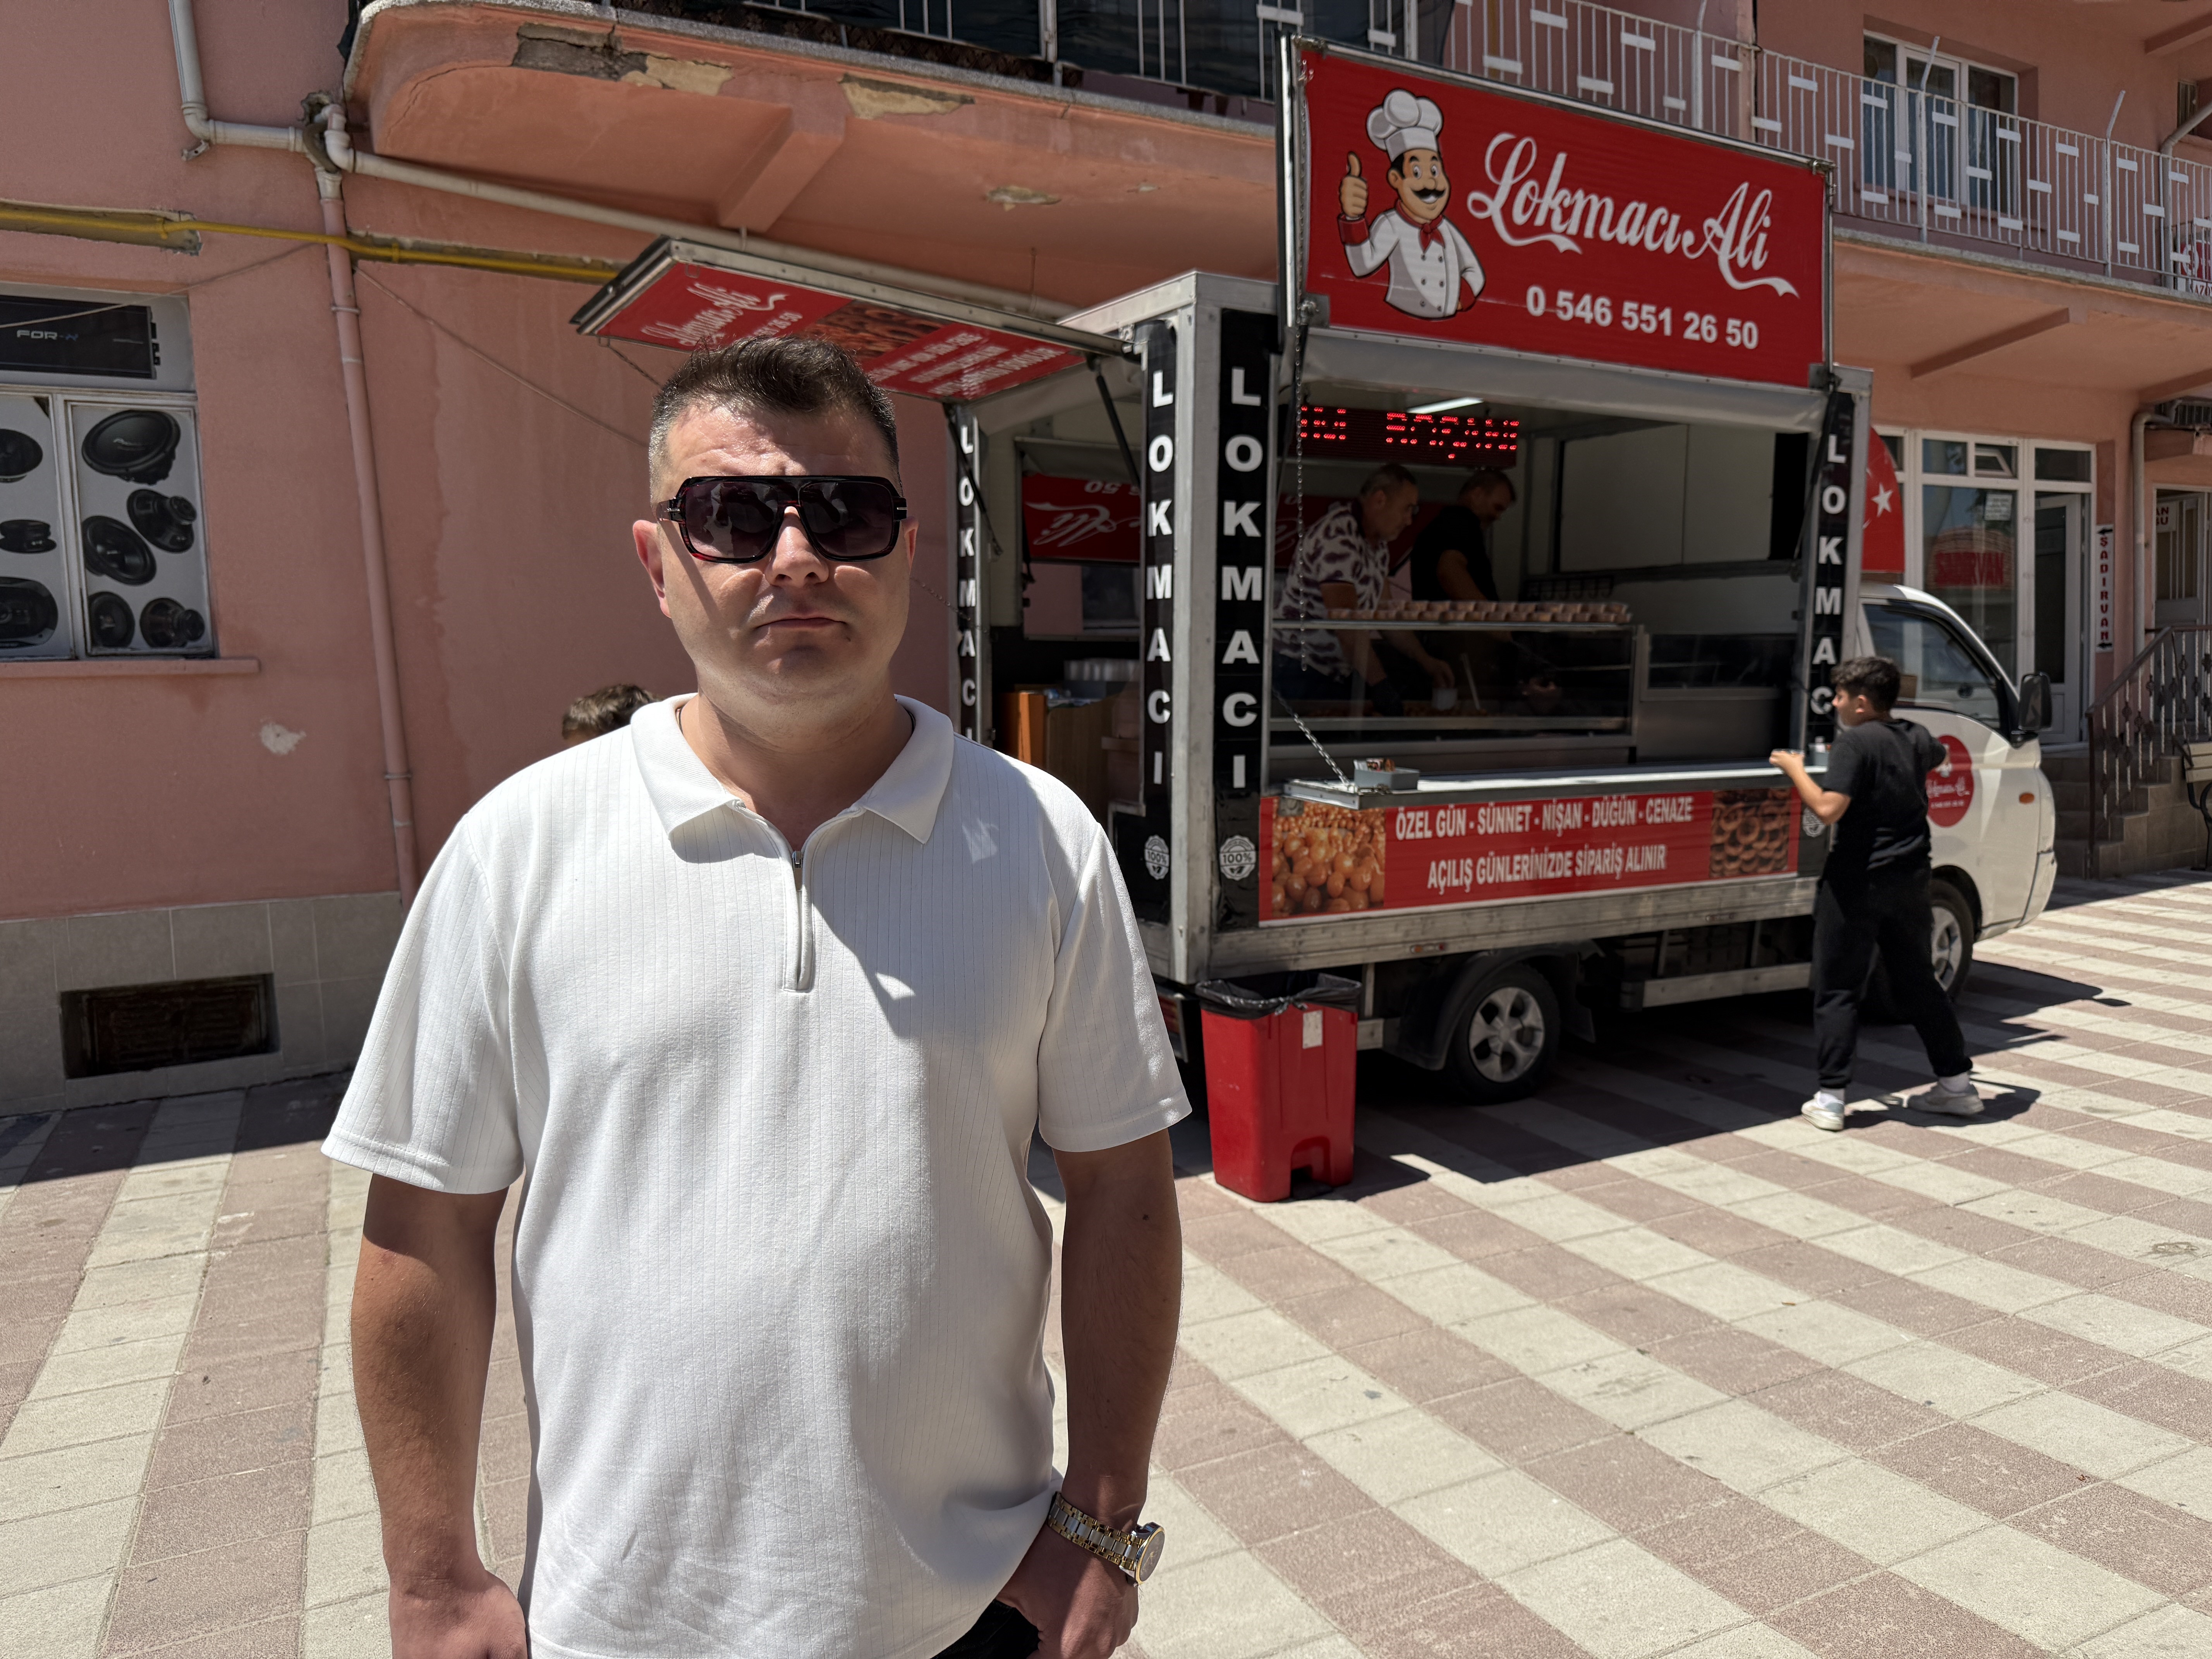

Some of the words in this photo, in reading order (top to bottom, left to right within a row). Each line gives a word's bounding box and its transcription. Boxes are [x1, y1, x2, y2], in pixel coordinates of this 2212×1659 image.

[1682, 181, 1800, 299] Ali
[1526, 285, 1546, 316] 0
[1556, 290, 1612, 327] 546
[1621, 299, 1673, 337] 551
[1683, 311, 1719, 344] 26
[1726, 318, 1759, 349] 50
[1146, 370, 1174, 785] LOKMACI
[1221, 367, 1263, 788] LOKMACI
[1810, 434, 1847, 743] LOKMAC
[1396, 806, 1432, 841] ÖZEL
[1436, 803, 1467, 838] GÜN
[1477, 801, 1533, 835] SÜNNET
[1542, 798, 1583, 837] NİŞAN
[1592, 794, 1638, 828] DÜĞÜN
[1645, 796, 1694, 824] CENAZE
[1147, 851, 1167, 864] 100%
[1223, 852, 1252, 864] 100%
[1427, 858, 1473, 895] AÇILIŞ
[1476, 847, 1573, 884] GÜNLERİNİZDE
[1575, 841, 1623, 880] SİPARİŞ
[1625, 844, 1666, 872] ALINIR
